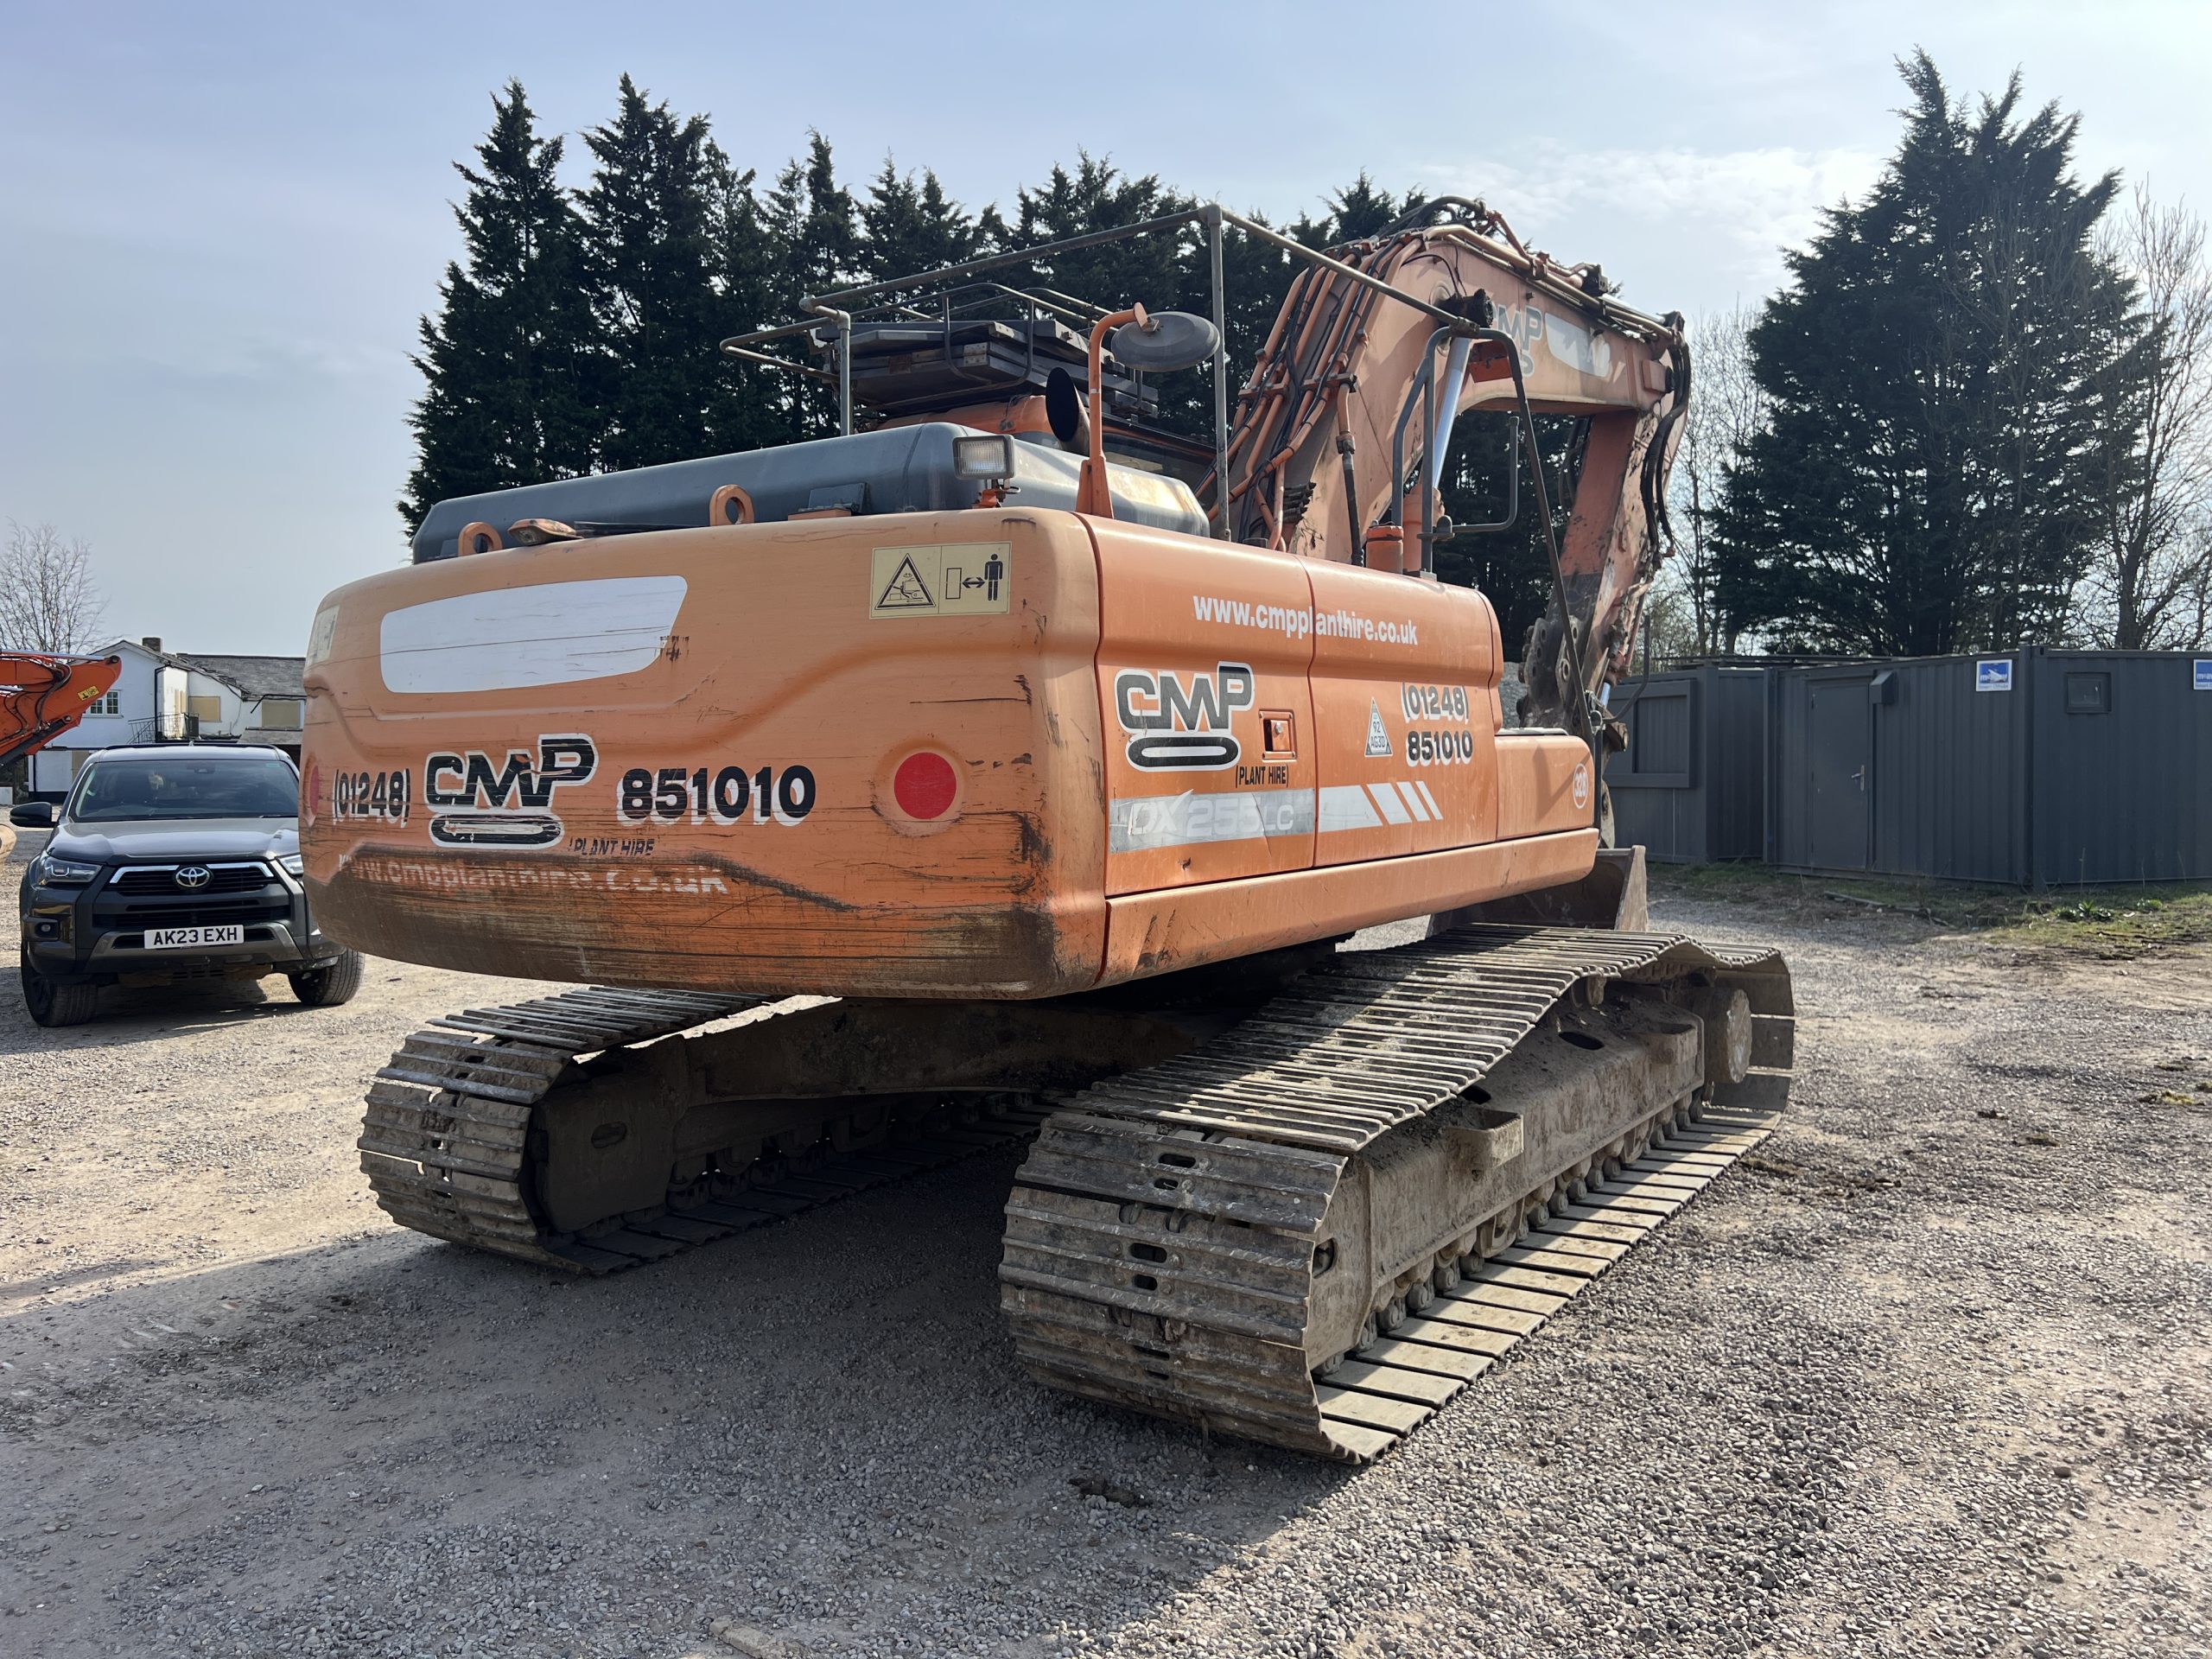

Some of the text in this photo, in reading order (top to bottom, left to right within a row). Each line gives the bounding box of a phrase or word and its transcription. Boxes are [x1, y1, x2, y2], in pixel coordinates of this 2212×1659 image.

[1492, 302, 1543, 353] MP
[1192, 595, 1418, 645] www.cmpplanthire.co.uk
[1115, 661, 1255, 734] CMP
[1401, 681, 1469, 725] (01248)
[1372, 721, 1381, 733] 92
[1406, 730, 1473, 767] 851010
[332, 768, 410, 829] (01248)
[423, 733, 600, 814] CMP
[616, 765, 817, 827] 851010
[1235, 764, 1289, 788] (PLANT HIRE)
[154, 926, 238, 945] AK23 EXH
